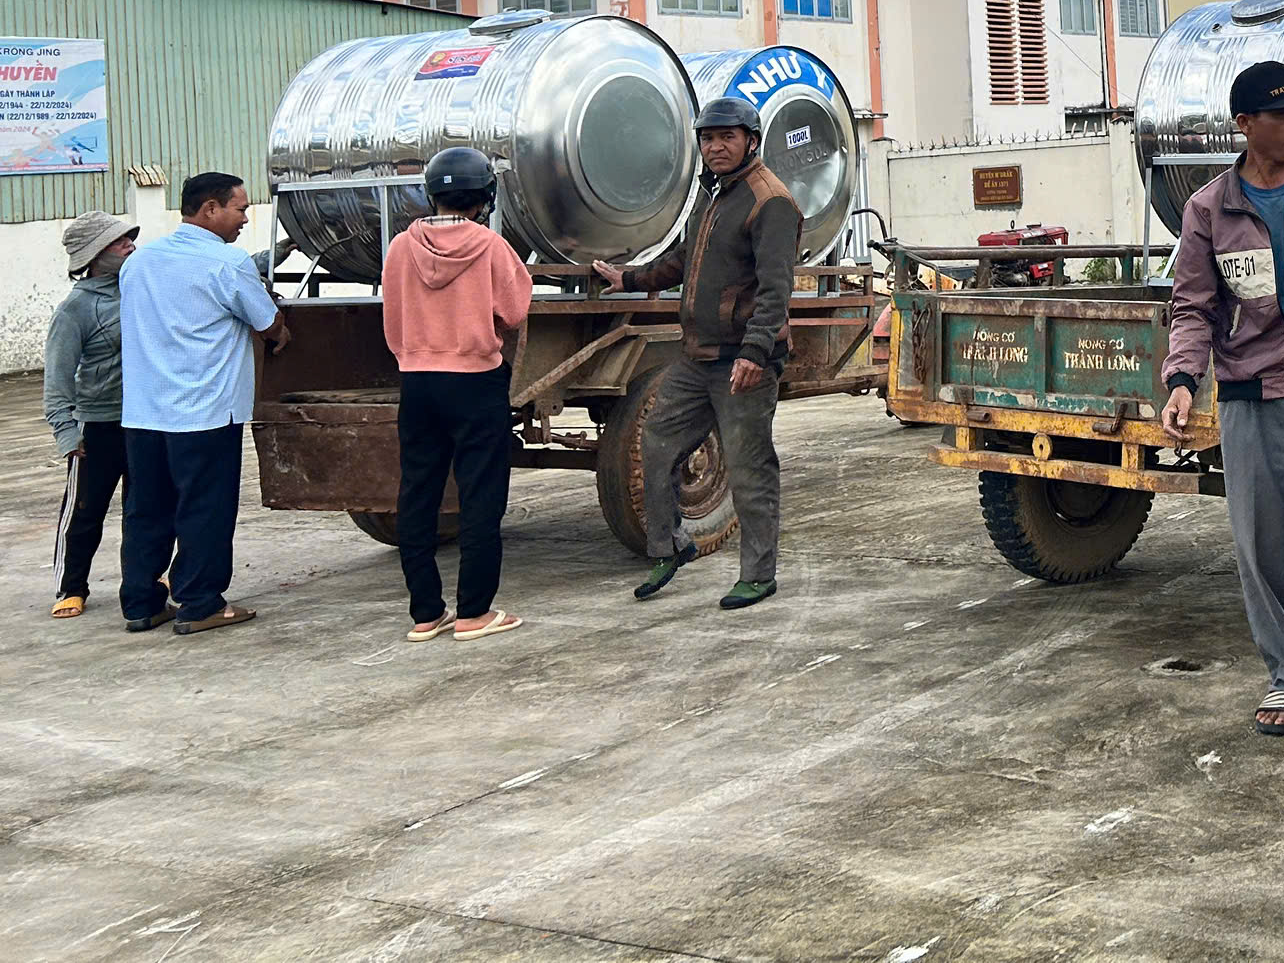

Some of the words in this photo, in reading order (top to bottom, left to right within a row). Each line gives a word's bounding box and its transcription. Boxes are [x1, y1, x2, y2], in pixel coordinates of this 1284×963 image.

[36, 48, 61, 56] JING
[737, 50, 802, 105] NHƯ
[30, 101, 72, 109] 22/12/2024)
[56, 112, 97, 120] 22/12/2024)
[788, 131, 808, 144] 1000L
[1064, 350, 1103, 369] THÀNH
[1108, 354, 1140, 371] LONG
